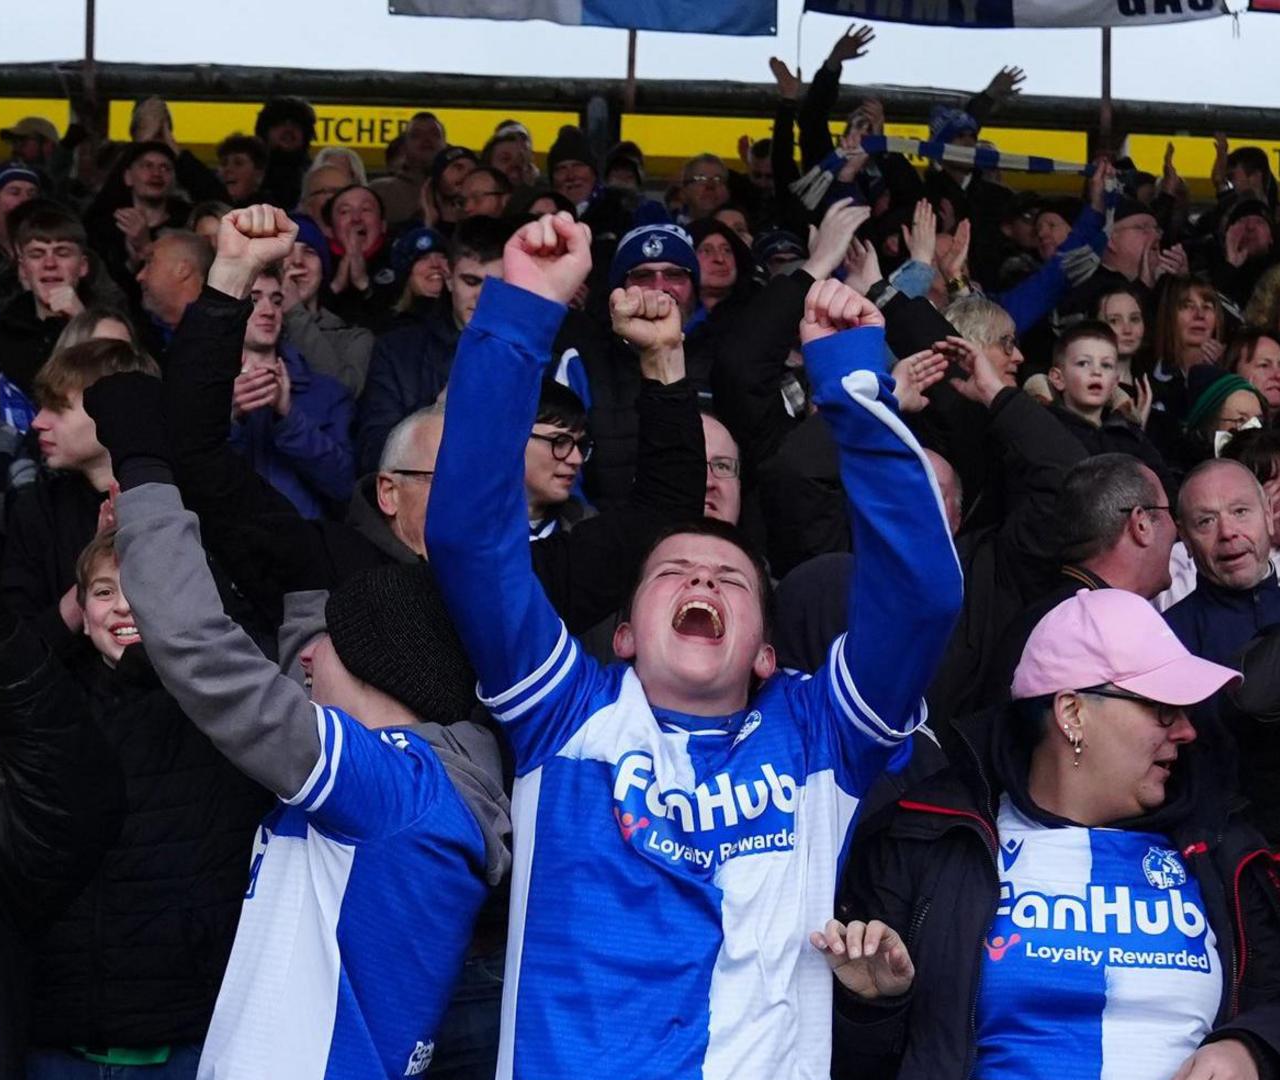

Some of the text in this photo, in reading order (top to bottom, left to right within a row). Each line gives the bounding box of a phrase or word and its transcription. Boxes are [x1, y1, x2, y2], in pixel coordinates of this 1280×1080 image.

[720, 828, 796, 862] Rewarde
[1025, 941, 1210, 970] Loyalty Rewarded
